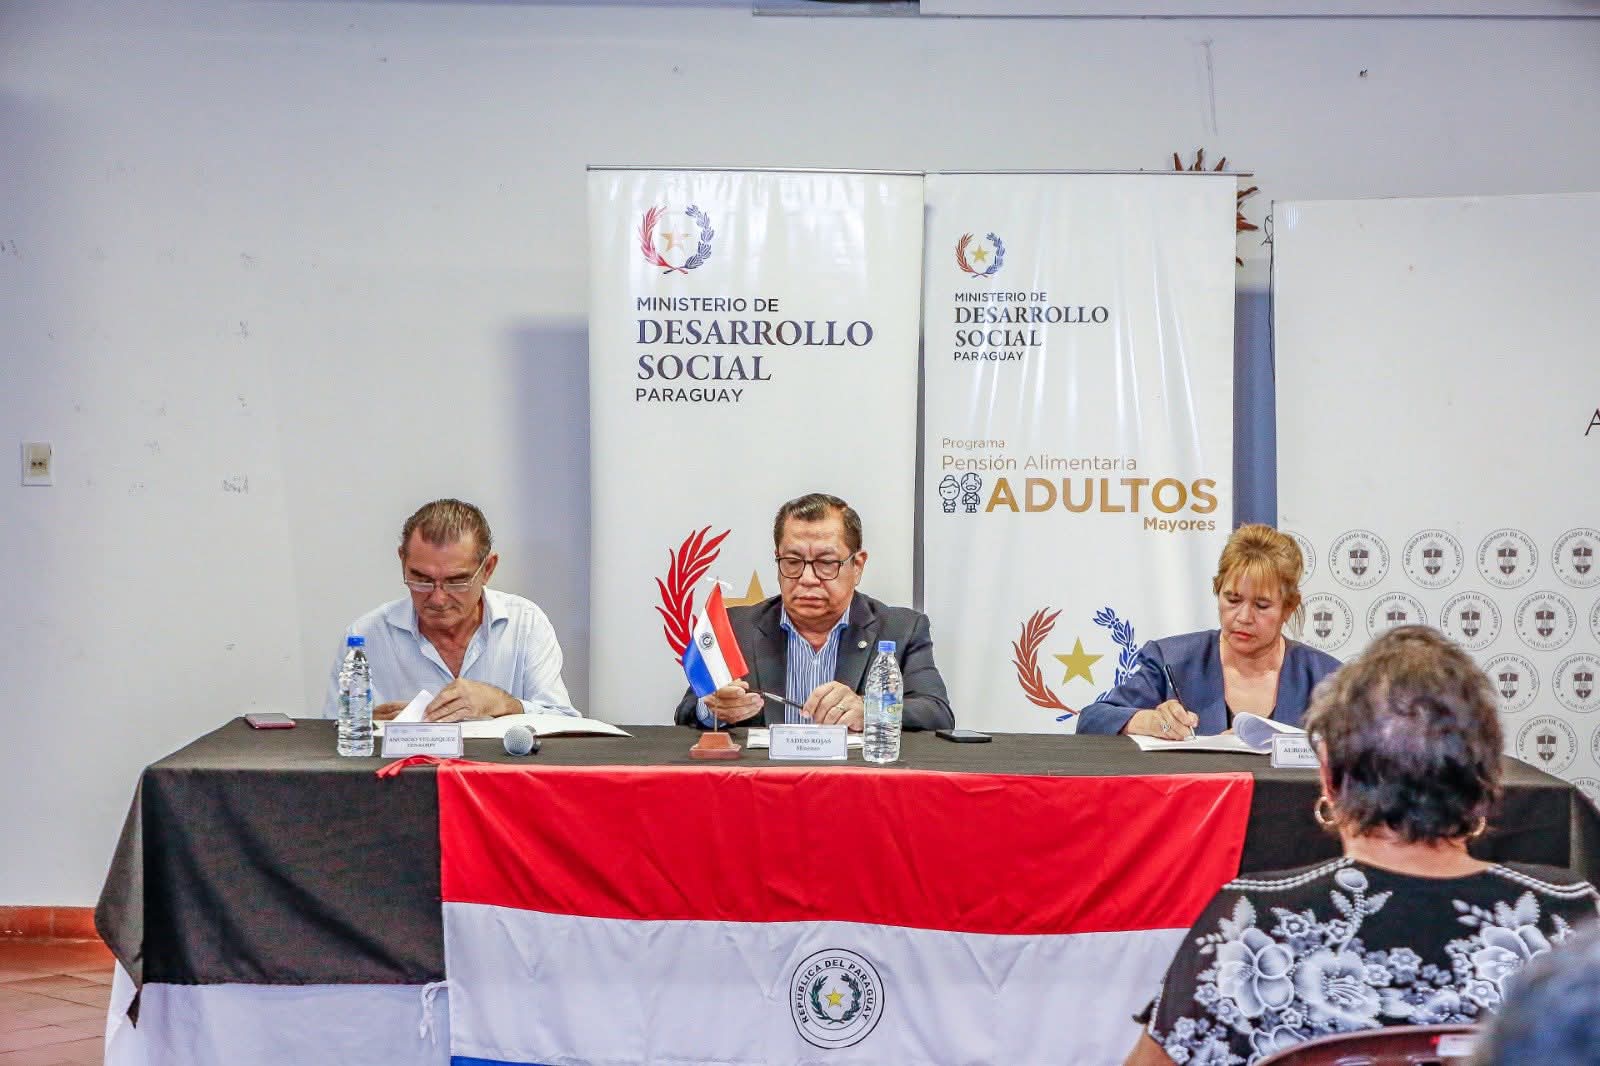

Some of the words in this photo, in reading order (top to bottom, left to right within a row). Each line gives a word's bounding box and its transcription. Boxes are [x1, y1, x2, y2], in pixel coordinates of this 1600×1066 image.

[636, 297, 747, 312] MINISTERIO
[754, 298, 779, 312] DE
[955, 292, 1027, 303] MINISTERIO
[1030, 292, 1047, 302] DE
[954, 306, 1109, 324] DESARROLLO
[636, 319, 874, 347] DESARROLLO
[955, 329, 1042, 348] SOCIAL
[953, 351, 1024, 361] PARAGUAY
[637, 354, 772, 381] SOCIAL
[636, 388, 744, 403] PARAGUAY
[942, 438, 1006, 450] Programa
[942, 454, 1017, 471] Pensión
[1024, 454, 1138, 471] Alimentaria
[985, 477, 1218, 514] ADULTOS
[1143, 516, 1216, 532] Mayores
[797, 965, 821, 1023] REPUBLICA
[825, 960, 845, 968] DEL
[848, 963, 874, 1020] PARAGUAY
